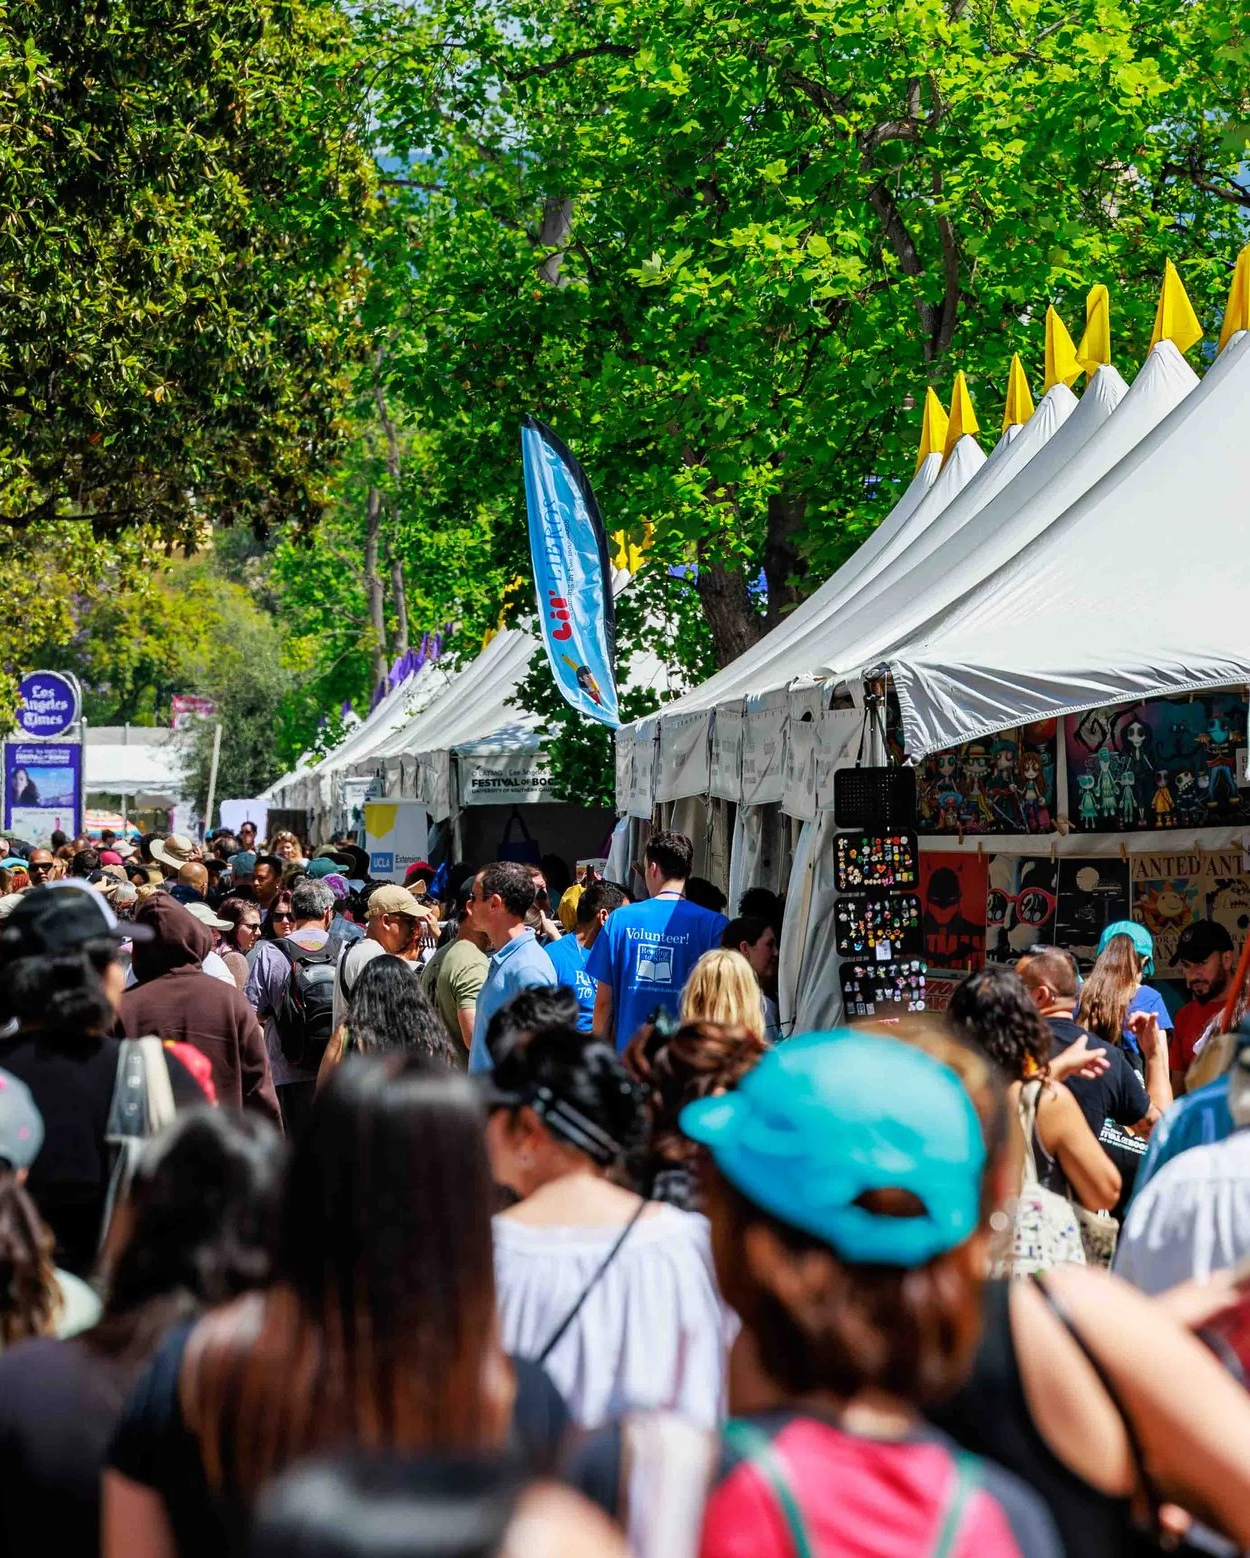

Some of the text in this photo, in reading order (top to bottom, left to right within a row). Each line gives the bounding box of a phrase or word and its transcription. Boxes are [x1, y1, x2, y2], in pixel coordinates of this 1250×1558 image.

[31, 685, 55, 698] Los
[21, 697, 68, 713] Angeles
[23, 711, 64, 728] Times
[472, 778, 520, 787] FESTIVAL
[373, 854, 422, 868] UCLA Extension
[626, 927, 690, 945] Volunteer!
[641, 947, 669, 957] Reading
